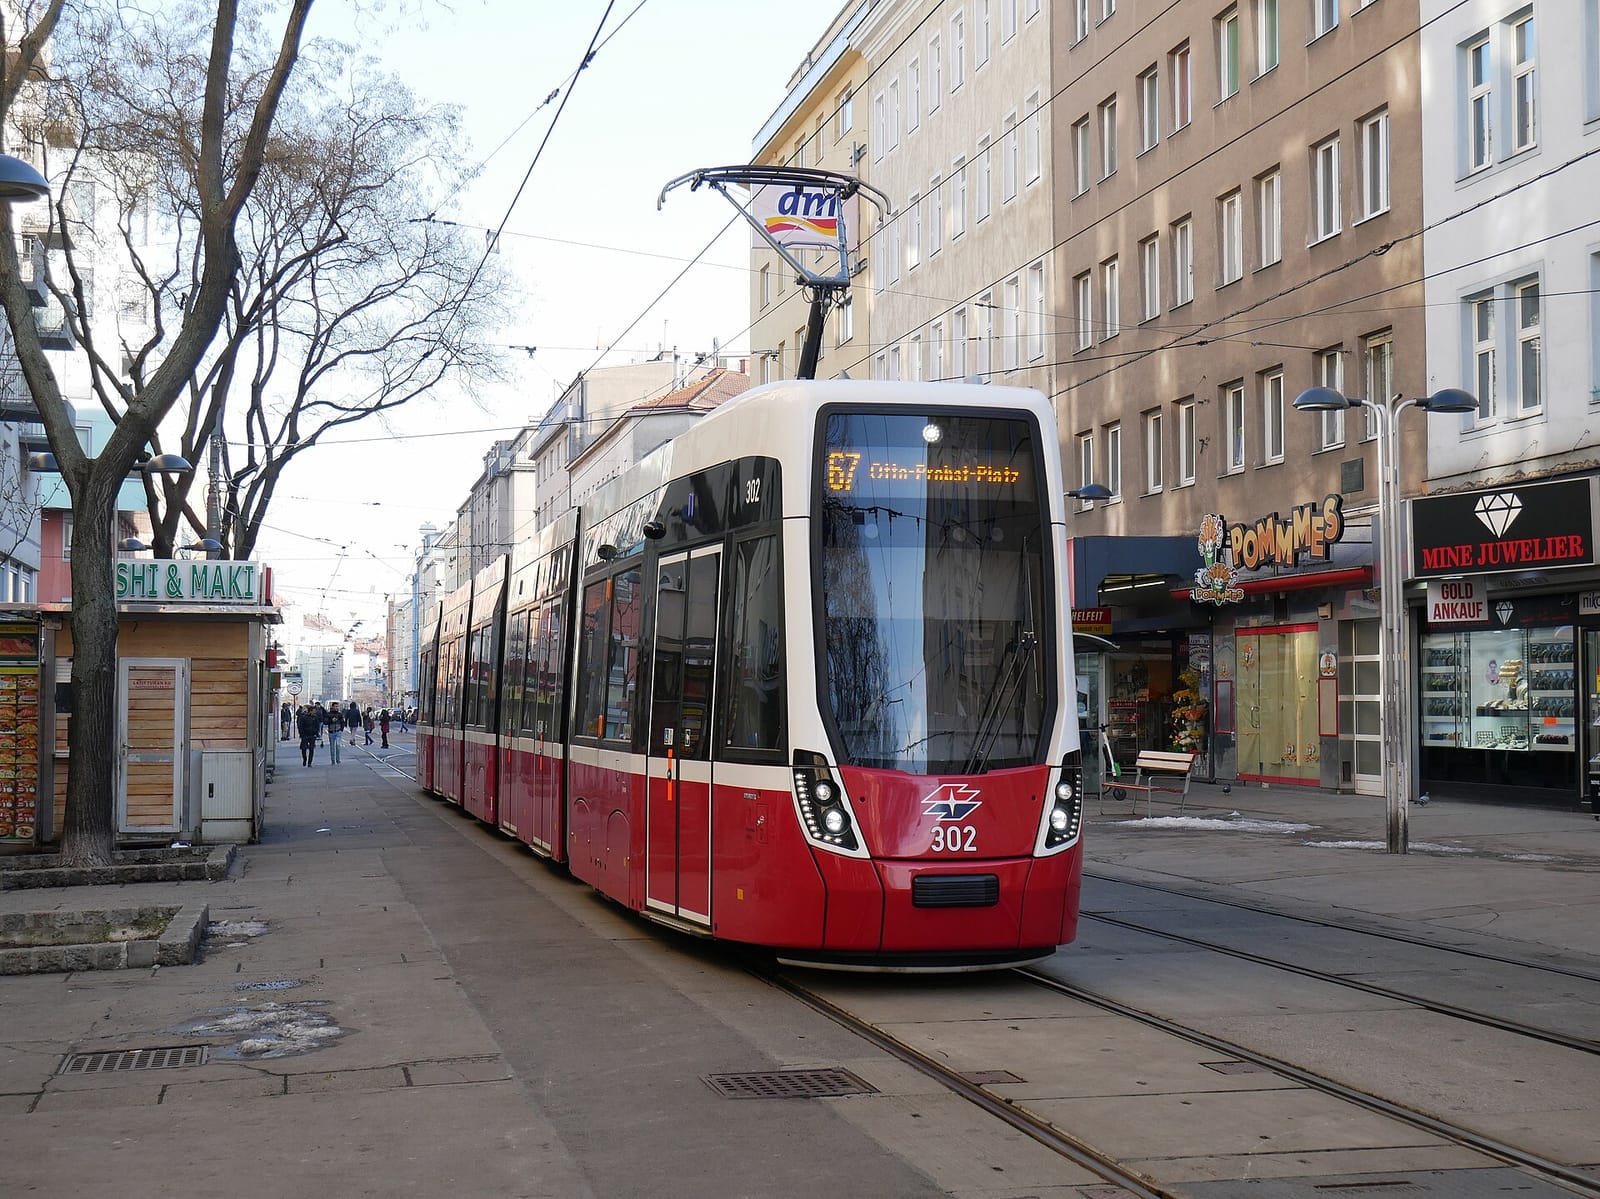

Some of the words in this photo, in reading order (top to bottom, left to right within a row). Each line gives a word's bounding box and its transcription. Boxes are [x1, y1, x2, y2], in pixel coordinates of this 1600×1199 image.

[828, 452, 861, 491] 67
[745, 477, 761, 504] 302
[1230, 496, 1341, 570] POMMMES
[1422, 544, 1473, 570] MINE
[1477, 534, 1585, 566] JUWELIER
[116, 563, 158, 597] SHI
[166, 563, 184, 598] &
[191, 564, 254, 599] MAKI
[1441, 582, 1474, 600] GOLD
[1433, 601, 1484, 620] ANKAUF
[930, 825, 978, 852] 302
